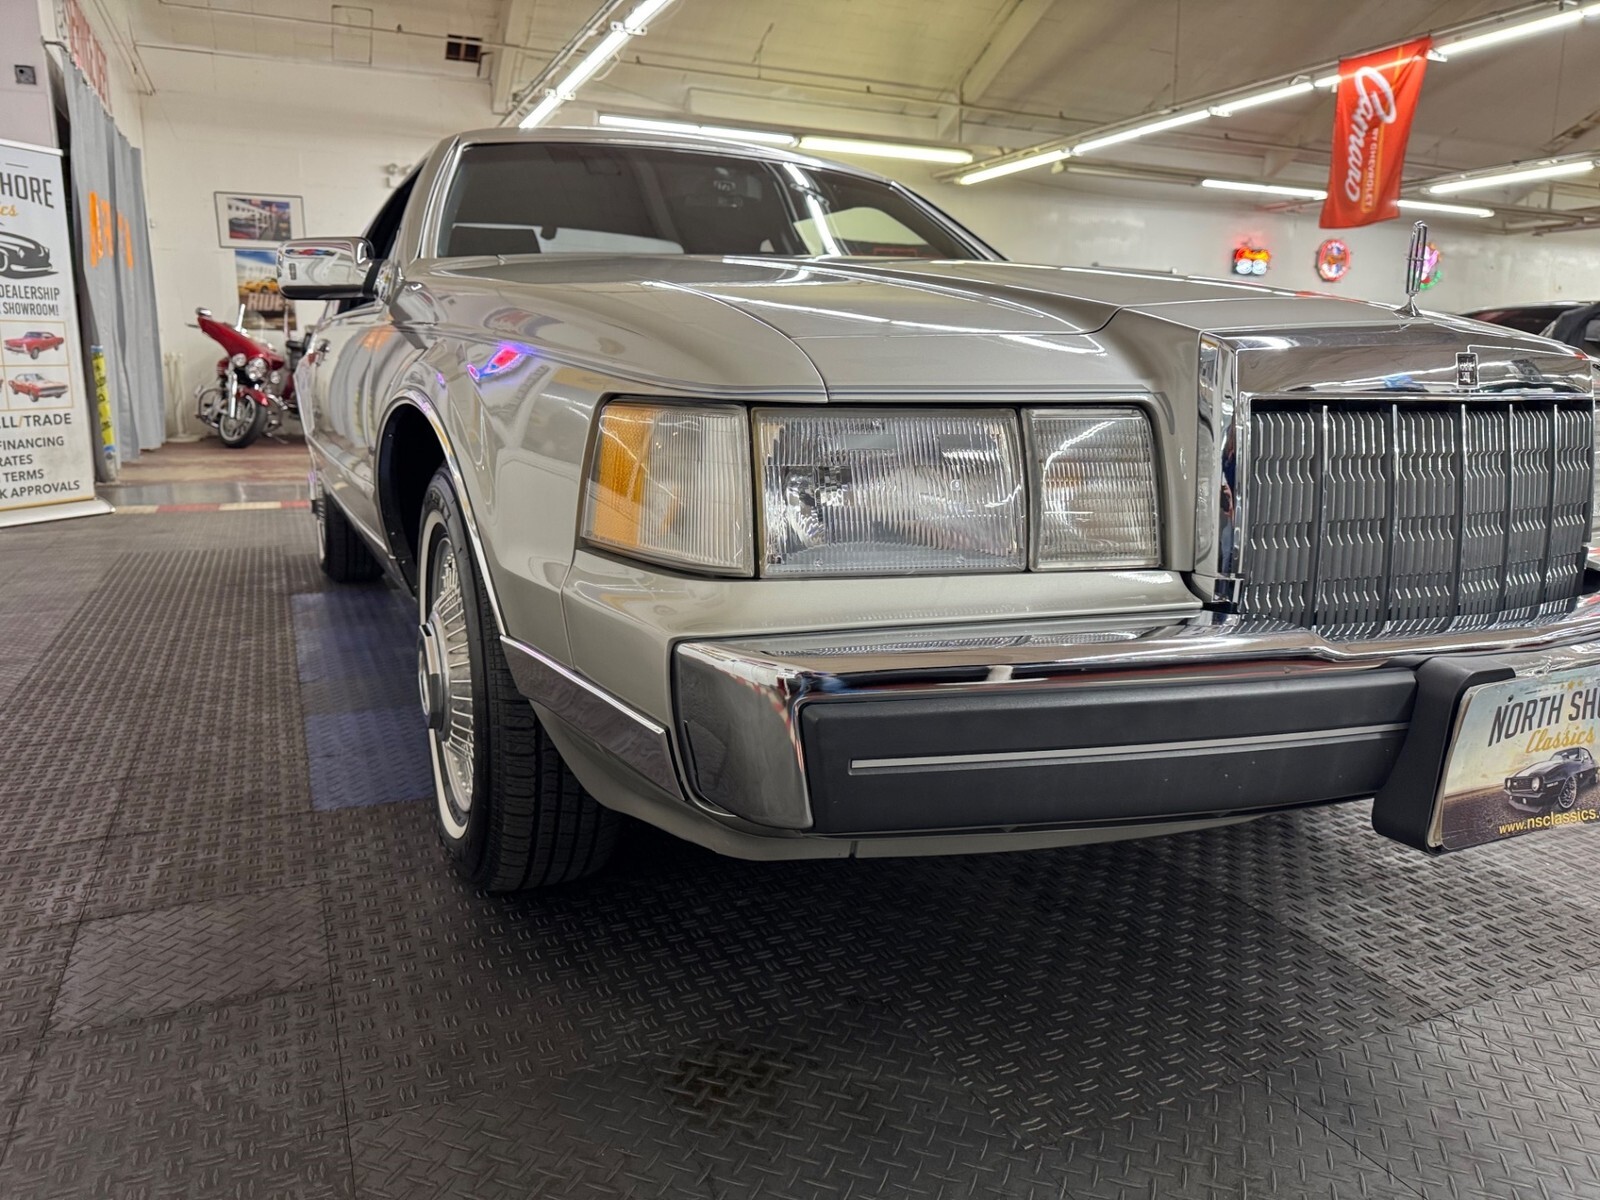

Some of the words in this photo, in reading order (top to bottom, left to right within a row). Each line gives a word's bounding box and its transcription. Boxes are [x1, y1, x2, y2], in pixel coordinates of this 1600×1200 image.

[1345, 66, 1397, 202] Camaro
[1371, 128, 1379, 140] BY
[1366, 143, 1377, 208] CHEVROLET
[3, 301, 60, 317] SHOWROOM!
[0, 413, 72, 429] LL/TRADE
[3, 468, 45, 483] TERMS
[10, 480, 80, 498] APPROVALS
[1488, 694, 1564, 747] NORTH
[1568, 687, 1600, 721] SH
[1525, 726, 1596, 754] Classics
[1499, 808, 1600, 834] www.nsclassics.
